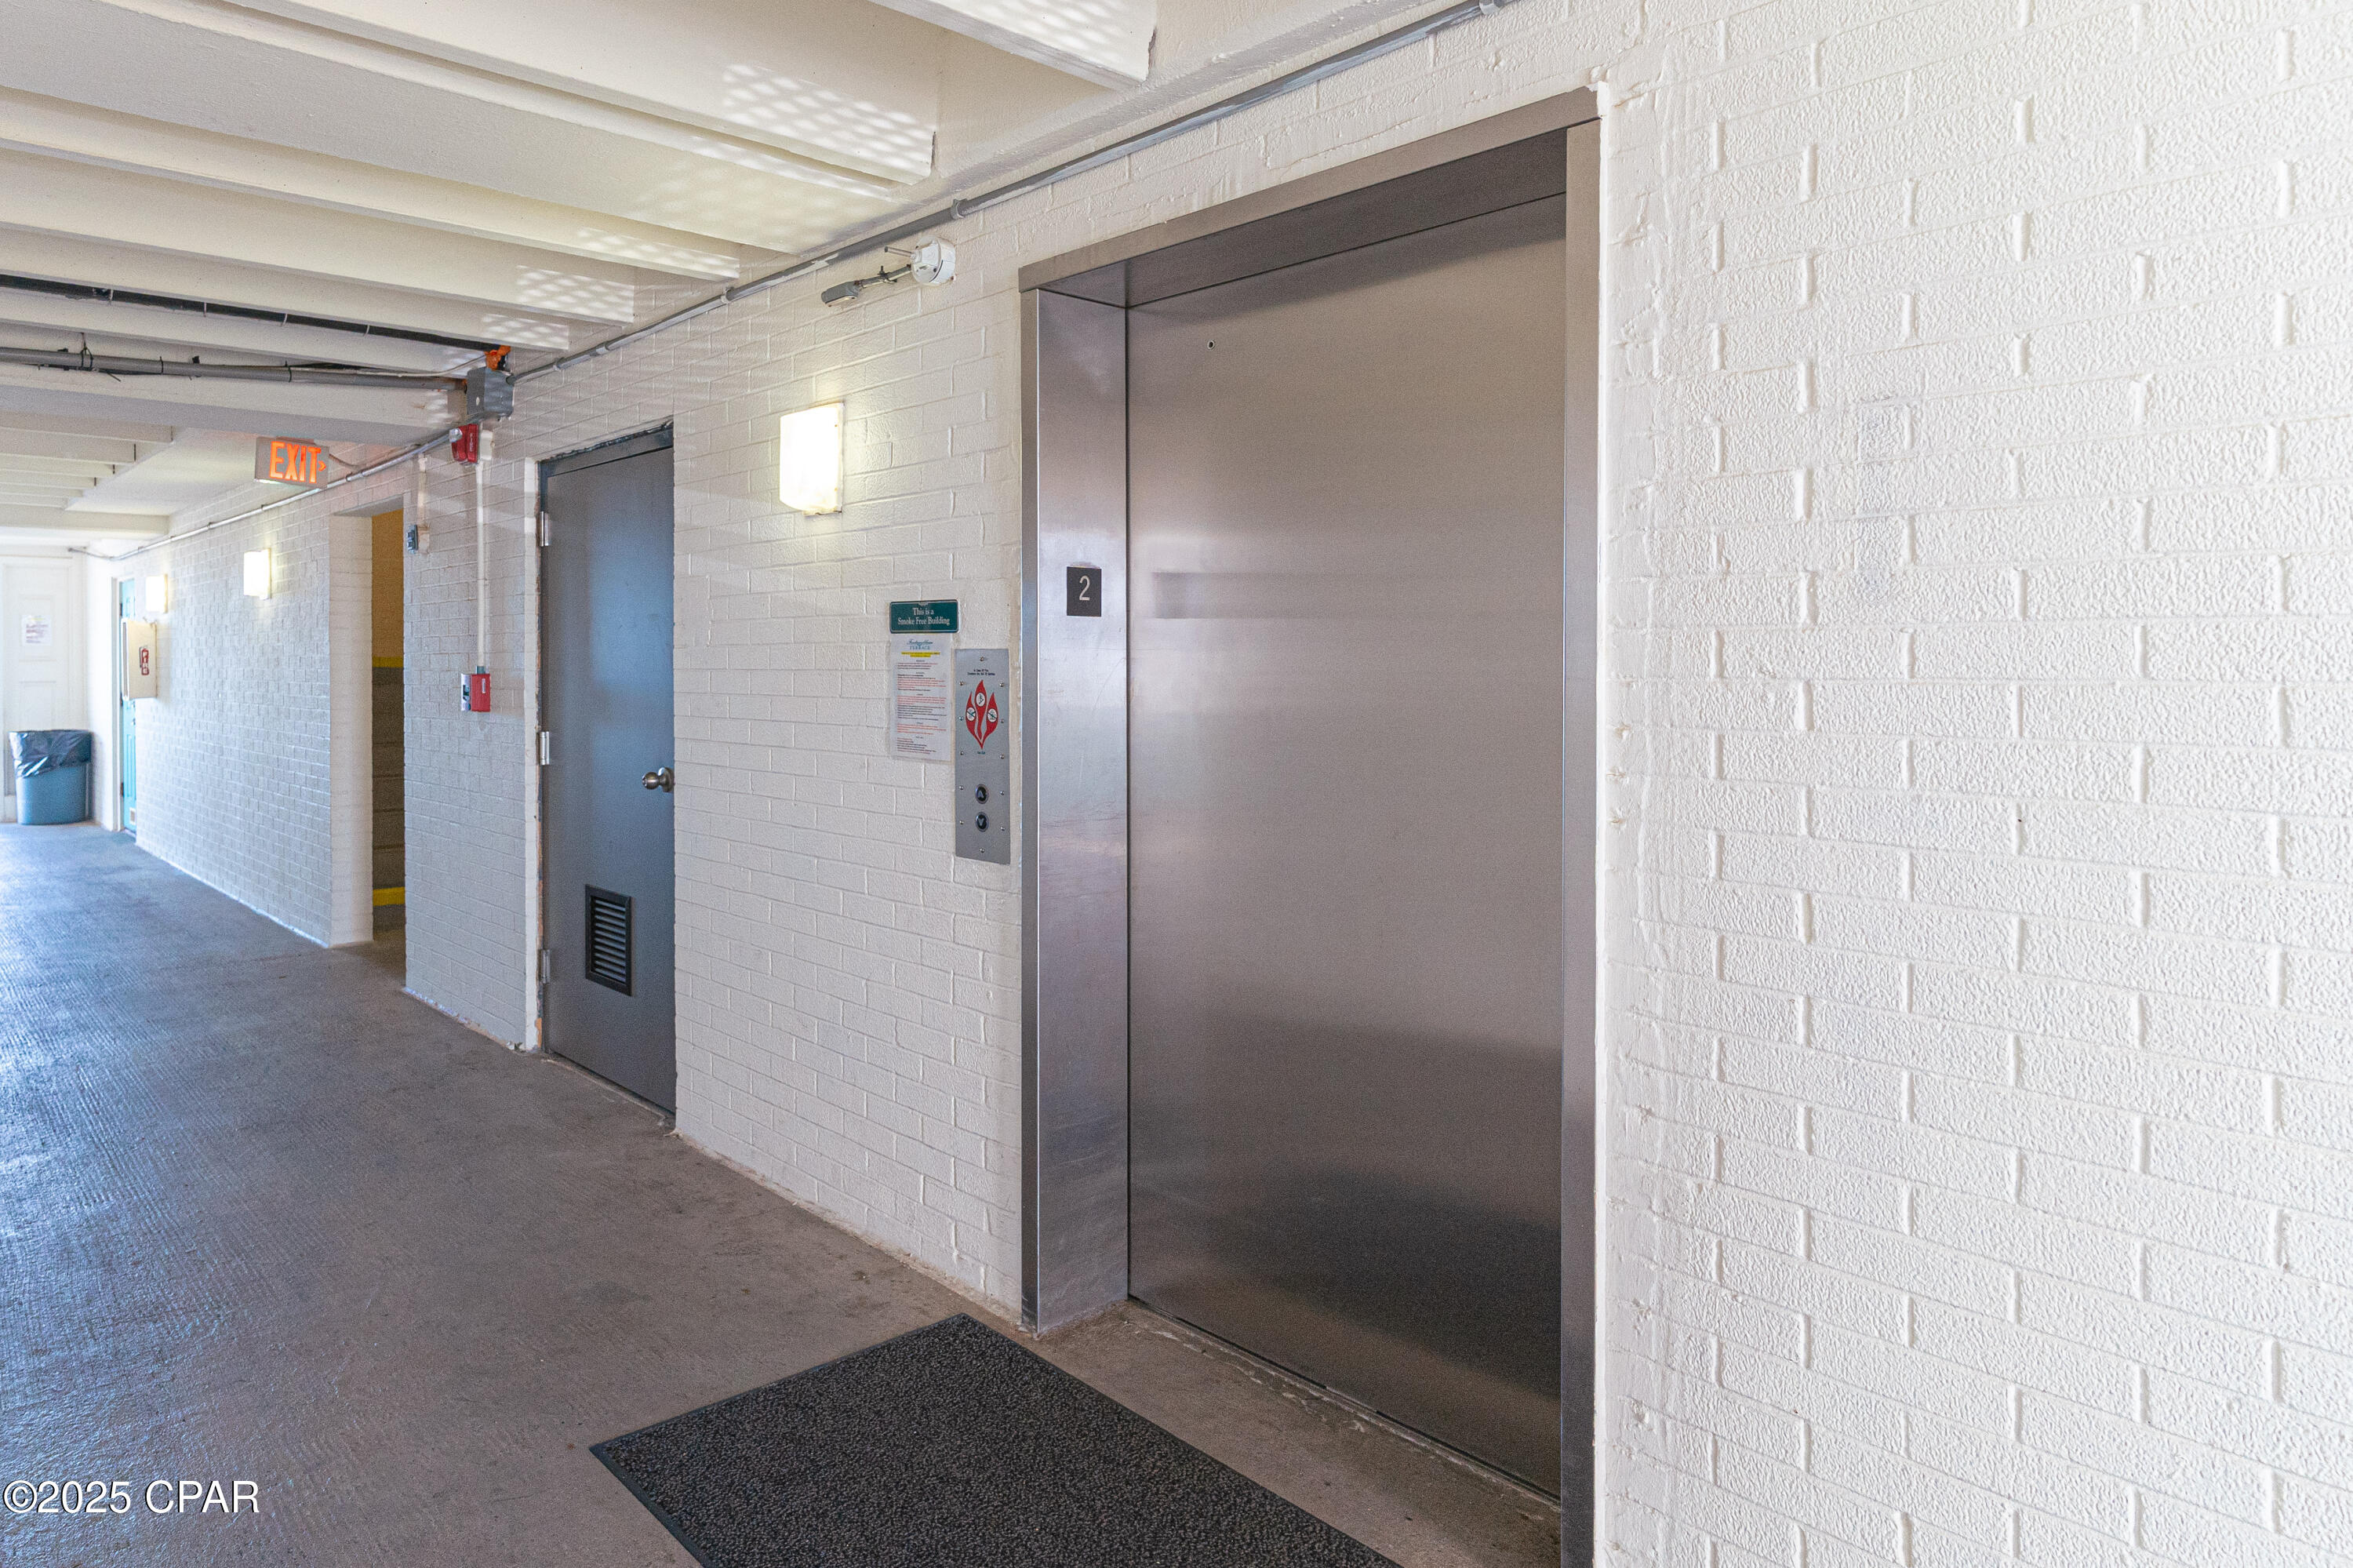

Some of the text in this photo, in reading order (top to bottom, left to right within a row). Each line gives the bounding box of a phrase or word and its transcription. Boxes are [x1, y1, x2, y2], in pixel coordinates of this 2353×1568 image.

[269, 441, 322, 484] EXIT
[1079, 575, 1090, 601] 2
[912, 607, 924, 616] This
[897, 617, 915, 625] Smoke
[928, 616, 951, 626] Building
